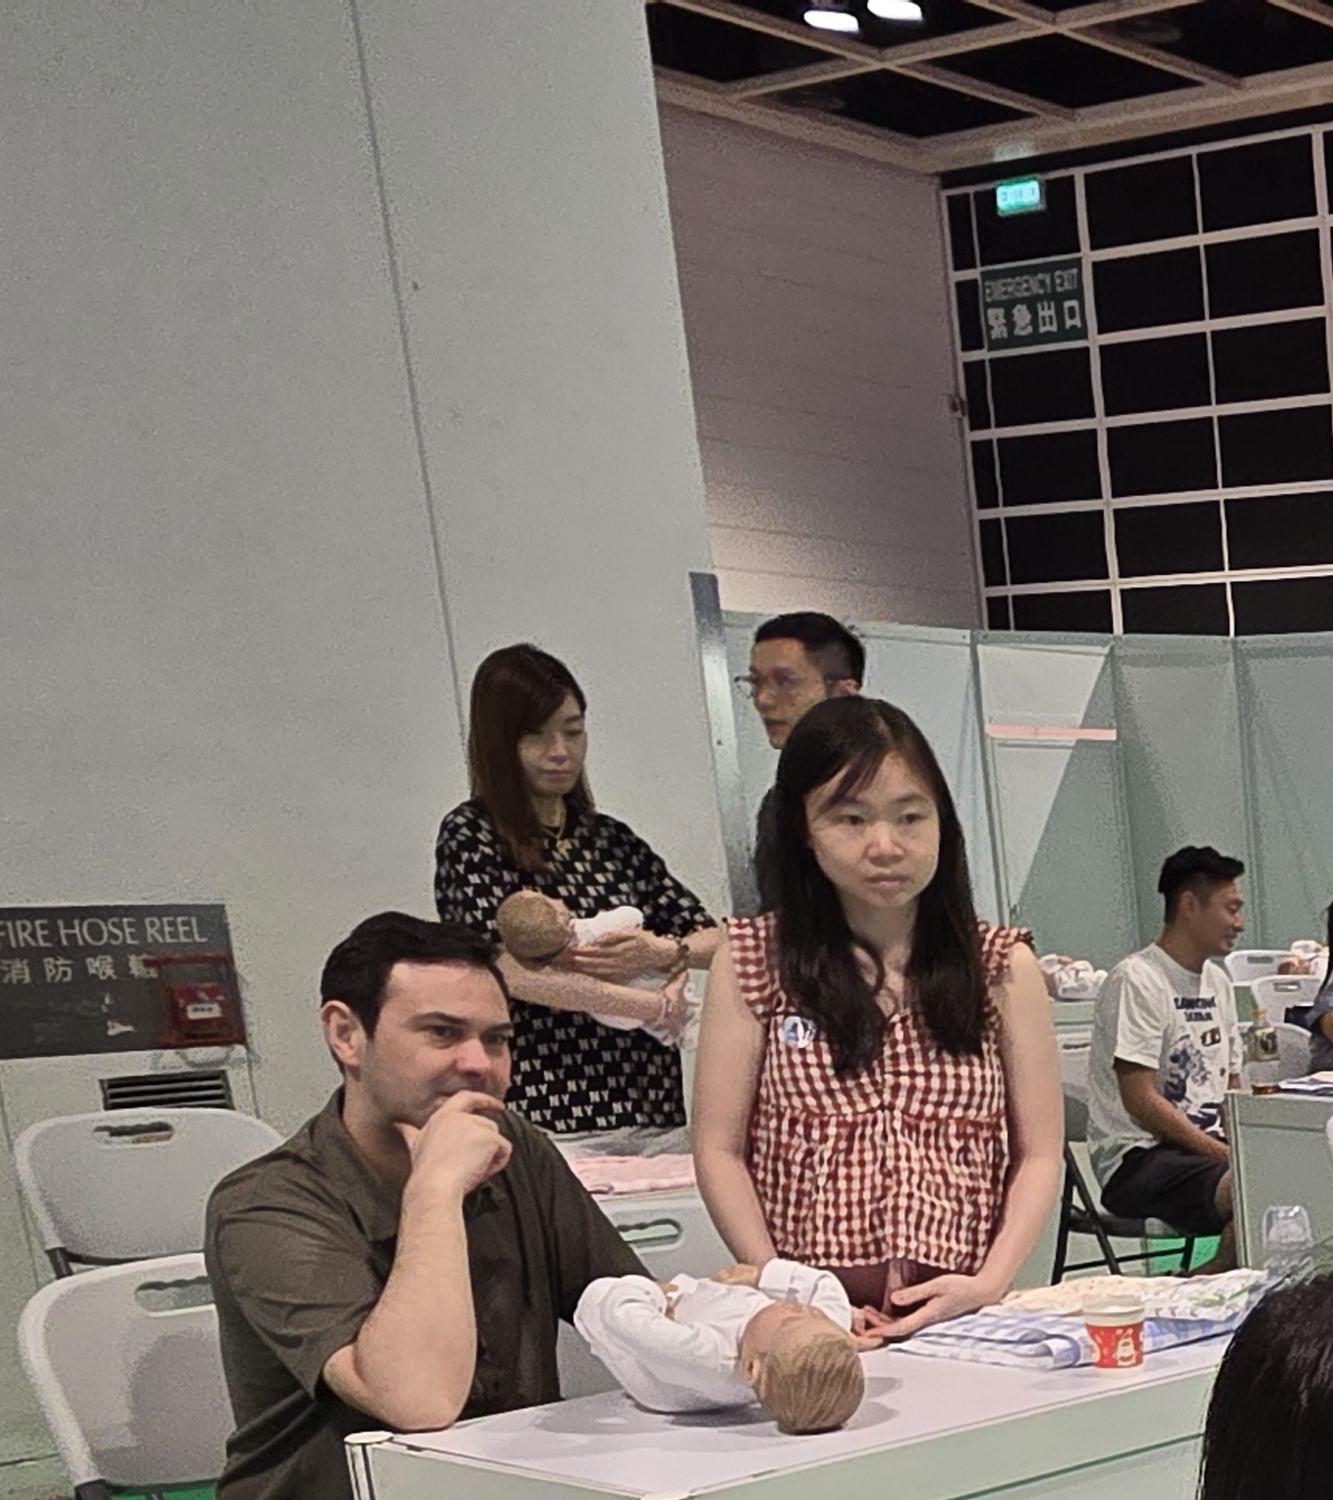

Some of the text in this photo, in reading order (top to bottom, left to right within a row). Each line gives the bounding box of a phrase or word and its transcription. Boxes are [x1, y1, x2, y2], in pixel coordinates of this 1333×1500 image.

[986, 299, 1082, 340] 緊急出口
[57, 916, 140, 947] HOSE
[145, 915, 208, 944] REEL
[525, 1084, 547, 1097] NY
[567, 1080, 587, 1092] NY
[549, 1094, 569, 1106] NY
[589, 1090, 609, 1102] NY
[572, 1106, 593, 1117] NY
[613, 1102, 632, 1113] NY
[530, 1110, 552, 1121] NY
[555, 1119, 576, 1131] NY
